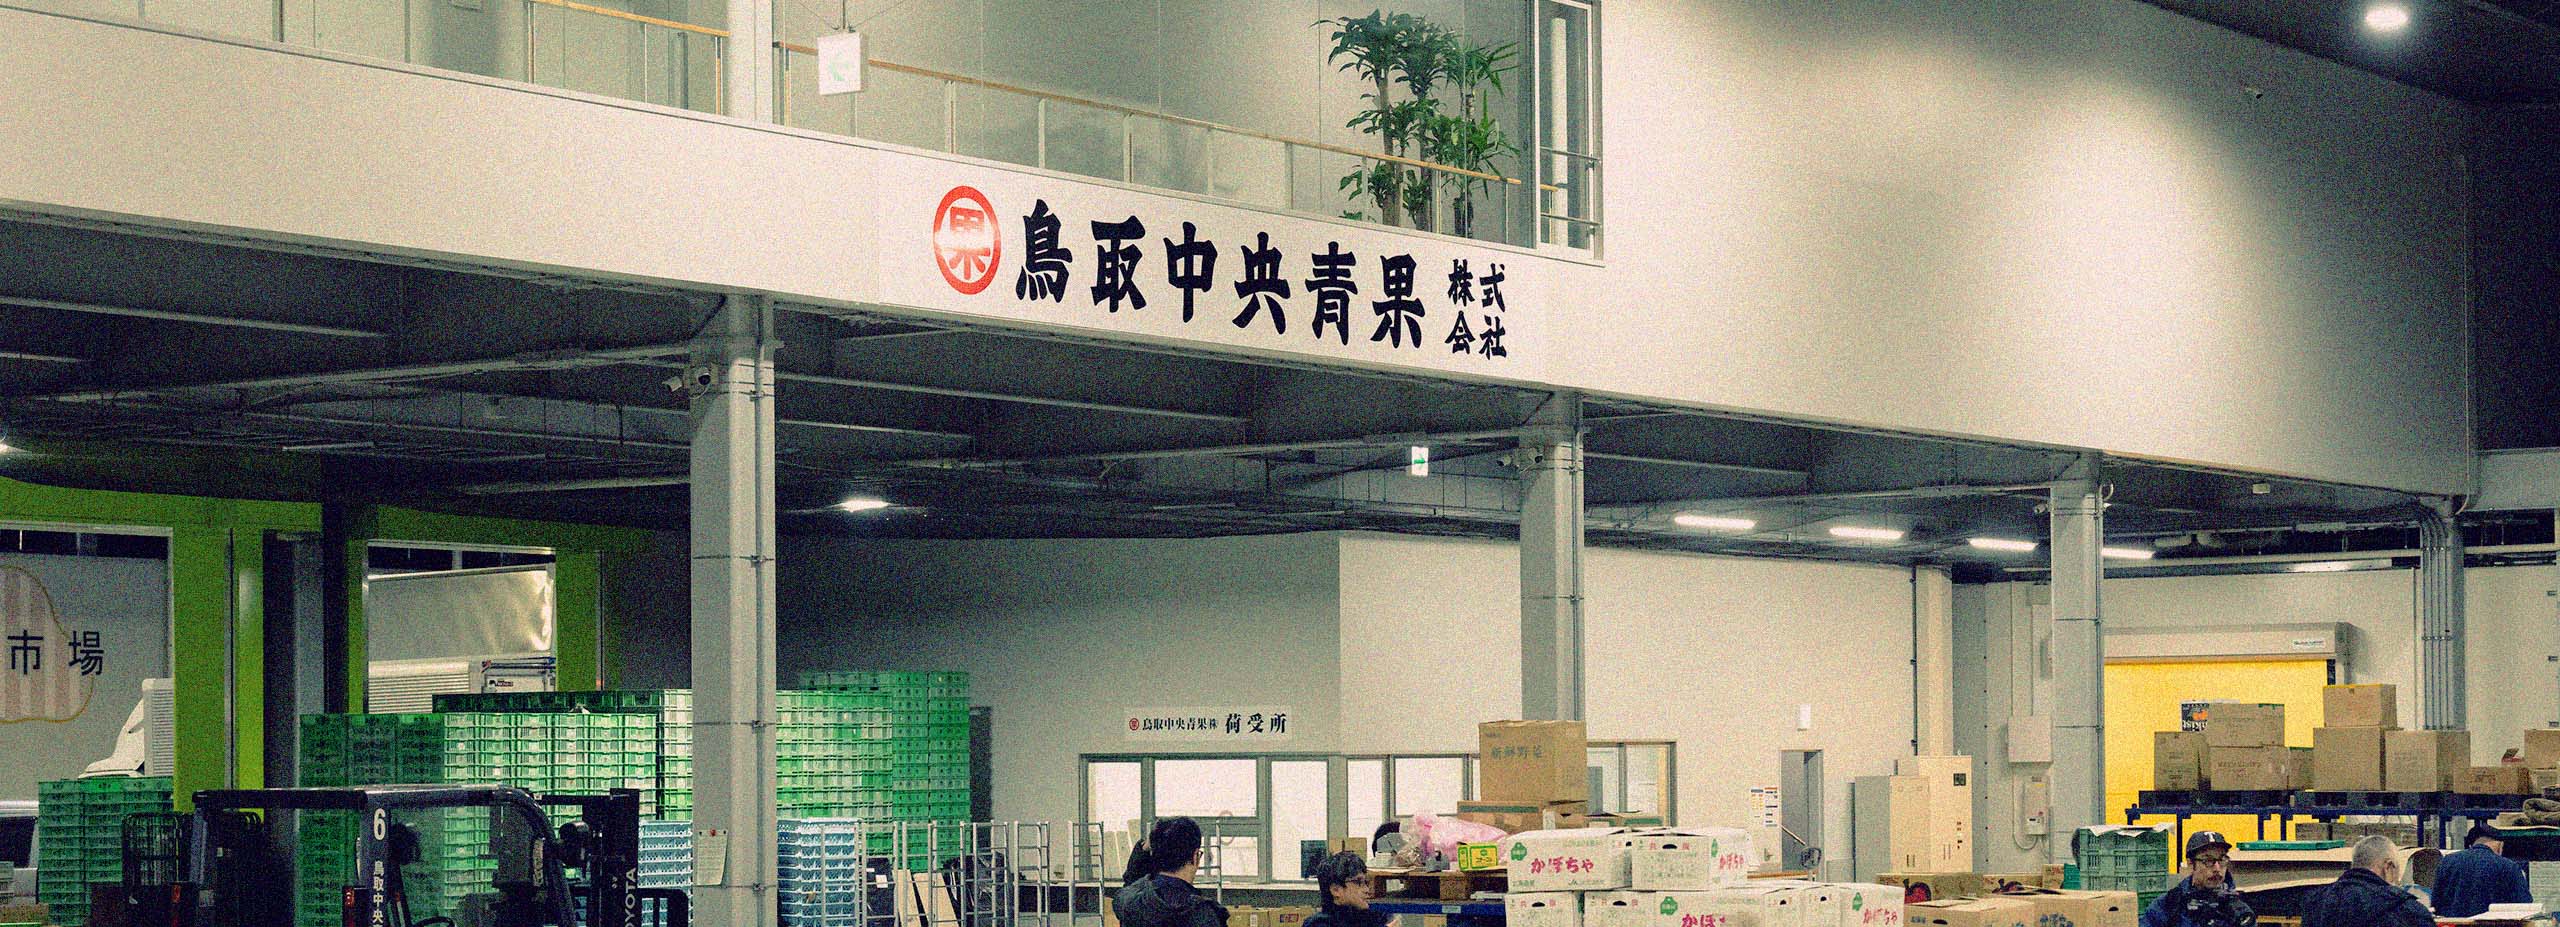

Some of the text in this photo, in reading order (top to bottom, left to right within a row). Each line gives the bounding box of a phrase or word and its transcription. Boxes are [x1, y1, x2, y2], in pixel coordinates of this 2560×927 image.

[1015, 198, 1426, 349] 鳥取中央青果
[7, 629, 105, 676] 市場
[1225, 712, 1288, 734] 荷受所
[373, 808, 386, 841] 6
[2204, 832, 2216, 842] T
[1531, 856, 1595, 874] かぼちゃ
[371, 860, 385, 927] 鳥取中央
